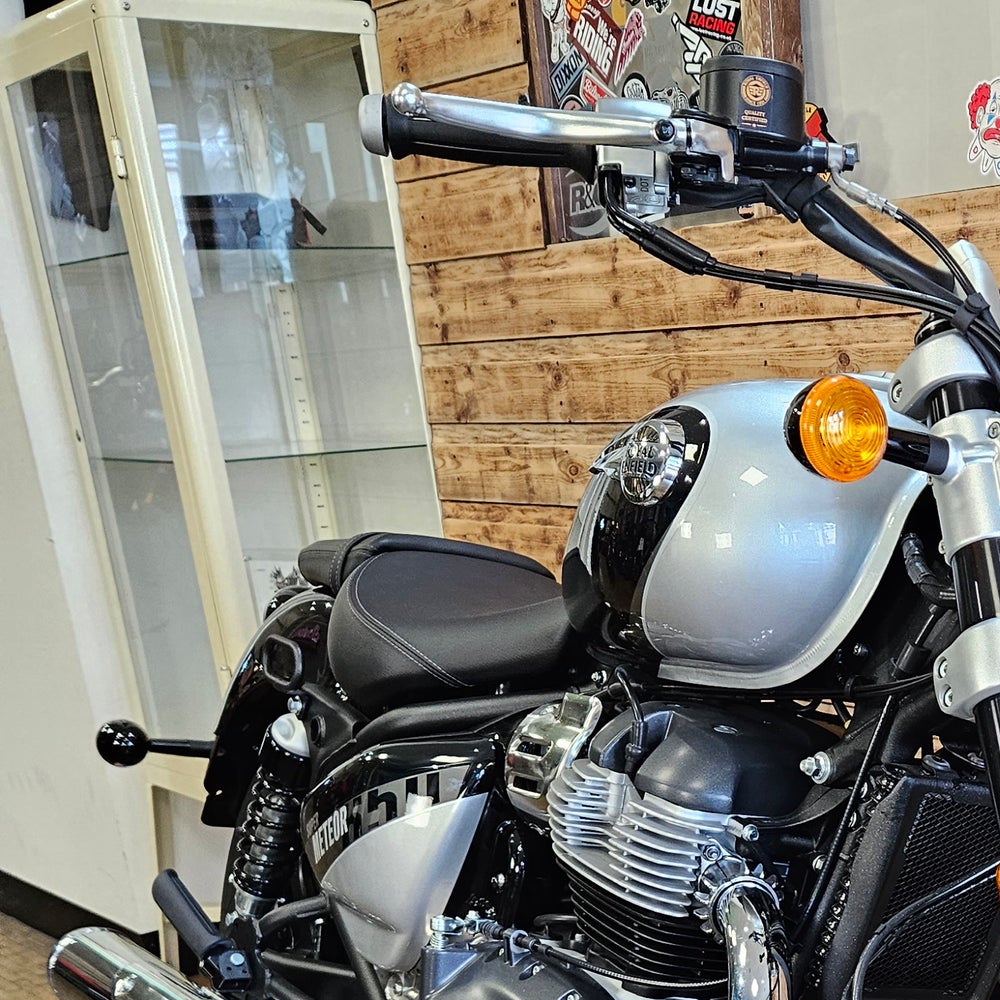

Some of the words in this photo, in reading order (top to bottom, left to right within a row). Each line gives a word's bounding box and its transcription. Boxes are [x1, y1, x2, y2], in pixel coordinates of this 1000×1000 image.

[573, 13, 614, 75] RIDING
[597, 15, 617, 50] We're
[689, 12, 736, 35] RACING
[554, 50, 583, 94] DIXXON
[311, 805, 349, 865] METEOR
